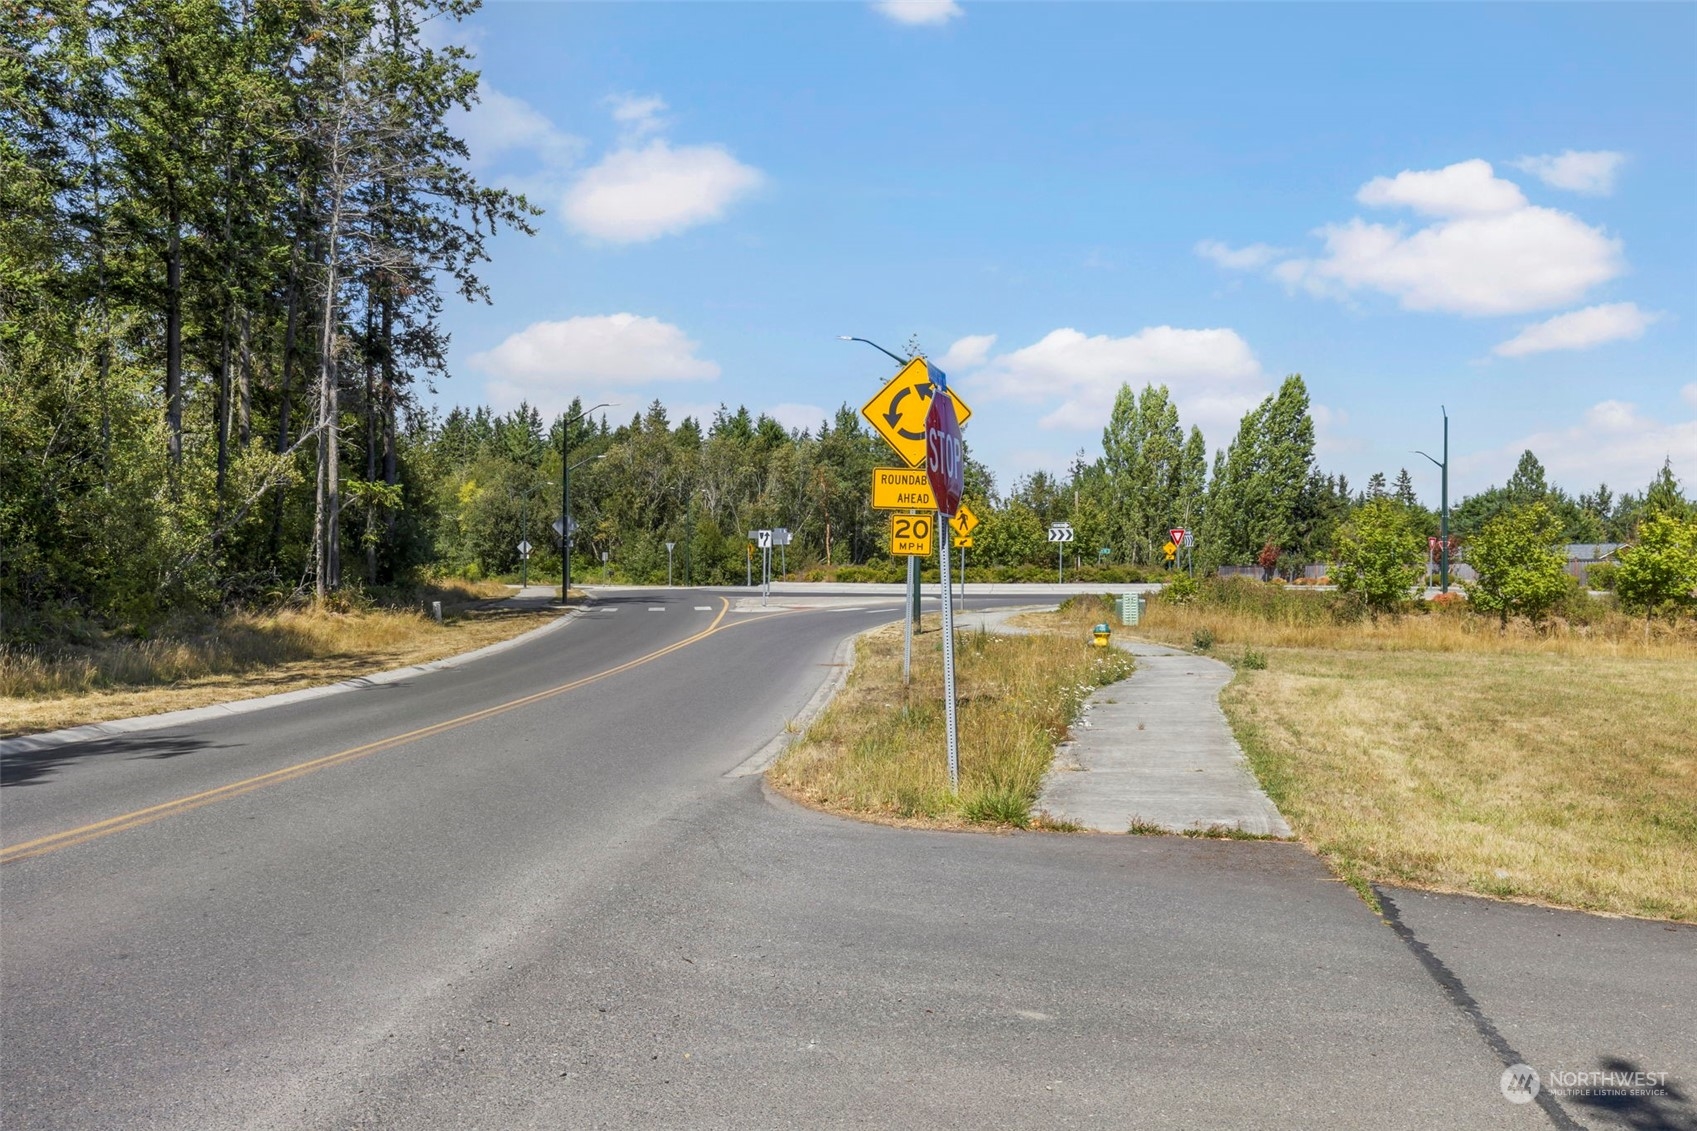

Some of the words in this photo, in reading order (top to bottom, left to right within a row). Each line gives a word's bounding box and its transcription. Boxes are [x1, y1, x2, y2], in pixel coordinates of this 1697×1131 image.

[929, 427, 961, 478] STOP
[881, 474, 929, 485] ROUNDAB
[897, 493, 929, 503] AHEAD
[895, 519, 929, 539] 20
[899, 543, 924, 551] MPH
